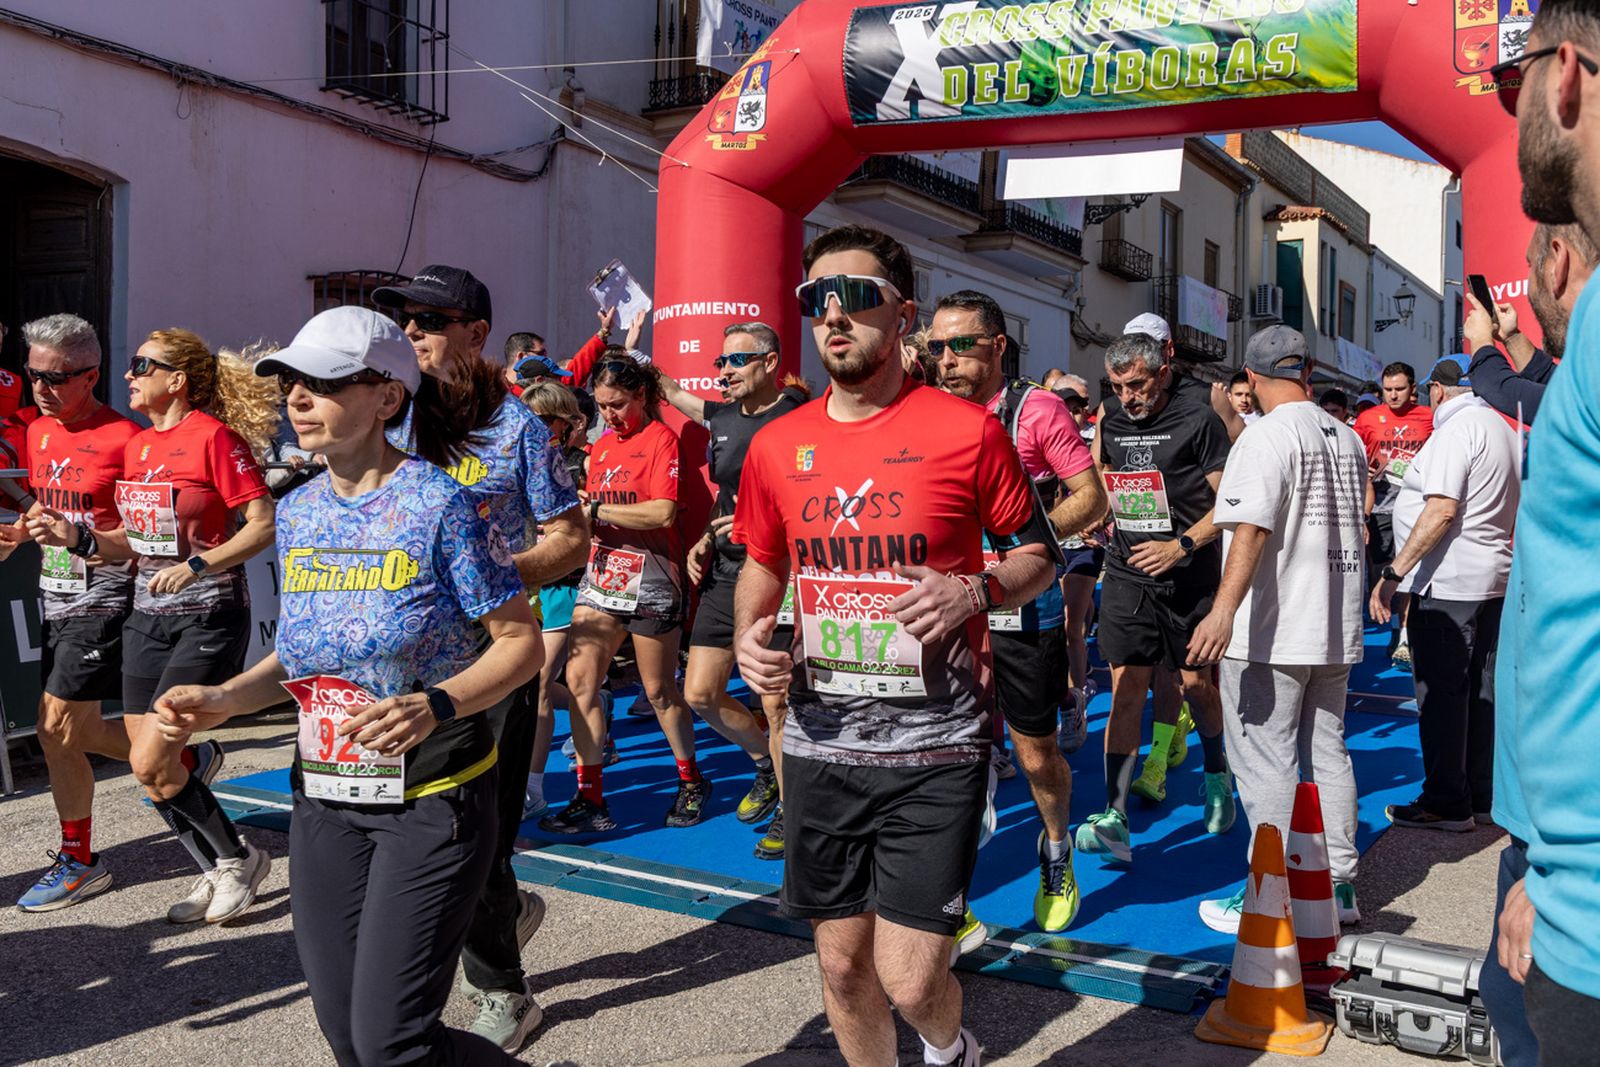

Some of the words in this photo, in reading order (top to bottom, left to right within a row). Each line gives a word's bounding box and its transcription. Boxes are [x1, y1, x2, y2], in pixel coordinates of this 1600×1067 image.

[894, 7, 933, 21] 2026
[938, 0, 1076, 48] CROSS
[940, 60, 1031, 107] DEL
[1056, 32, 1300, 98] VÍBORAS
[720, 142, 748, 150] MARTOS
[679, 340, 701, 353] DE
[36, 464, 85, 483] CROSS
[1111, 475, 1122, 487] X
[1121, 477, 1153, 487] CROSS
[118, 485, 129, 500] X
[129, 490, 161, 502] CROSS
[1117, 491, 1158, 514] 125
[801, 491, 905, 523] CROSS
[125, 508, 158, 534] 161
[794, 532, 928, 573] PANTANO
[593, 567, 630, 592] 123
[813, 583, 831, 607] X
[815, 606, 883, 623] PANTANO
[820, 618, 898, 663] 817
[318, 717, 361, 763] 92
